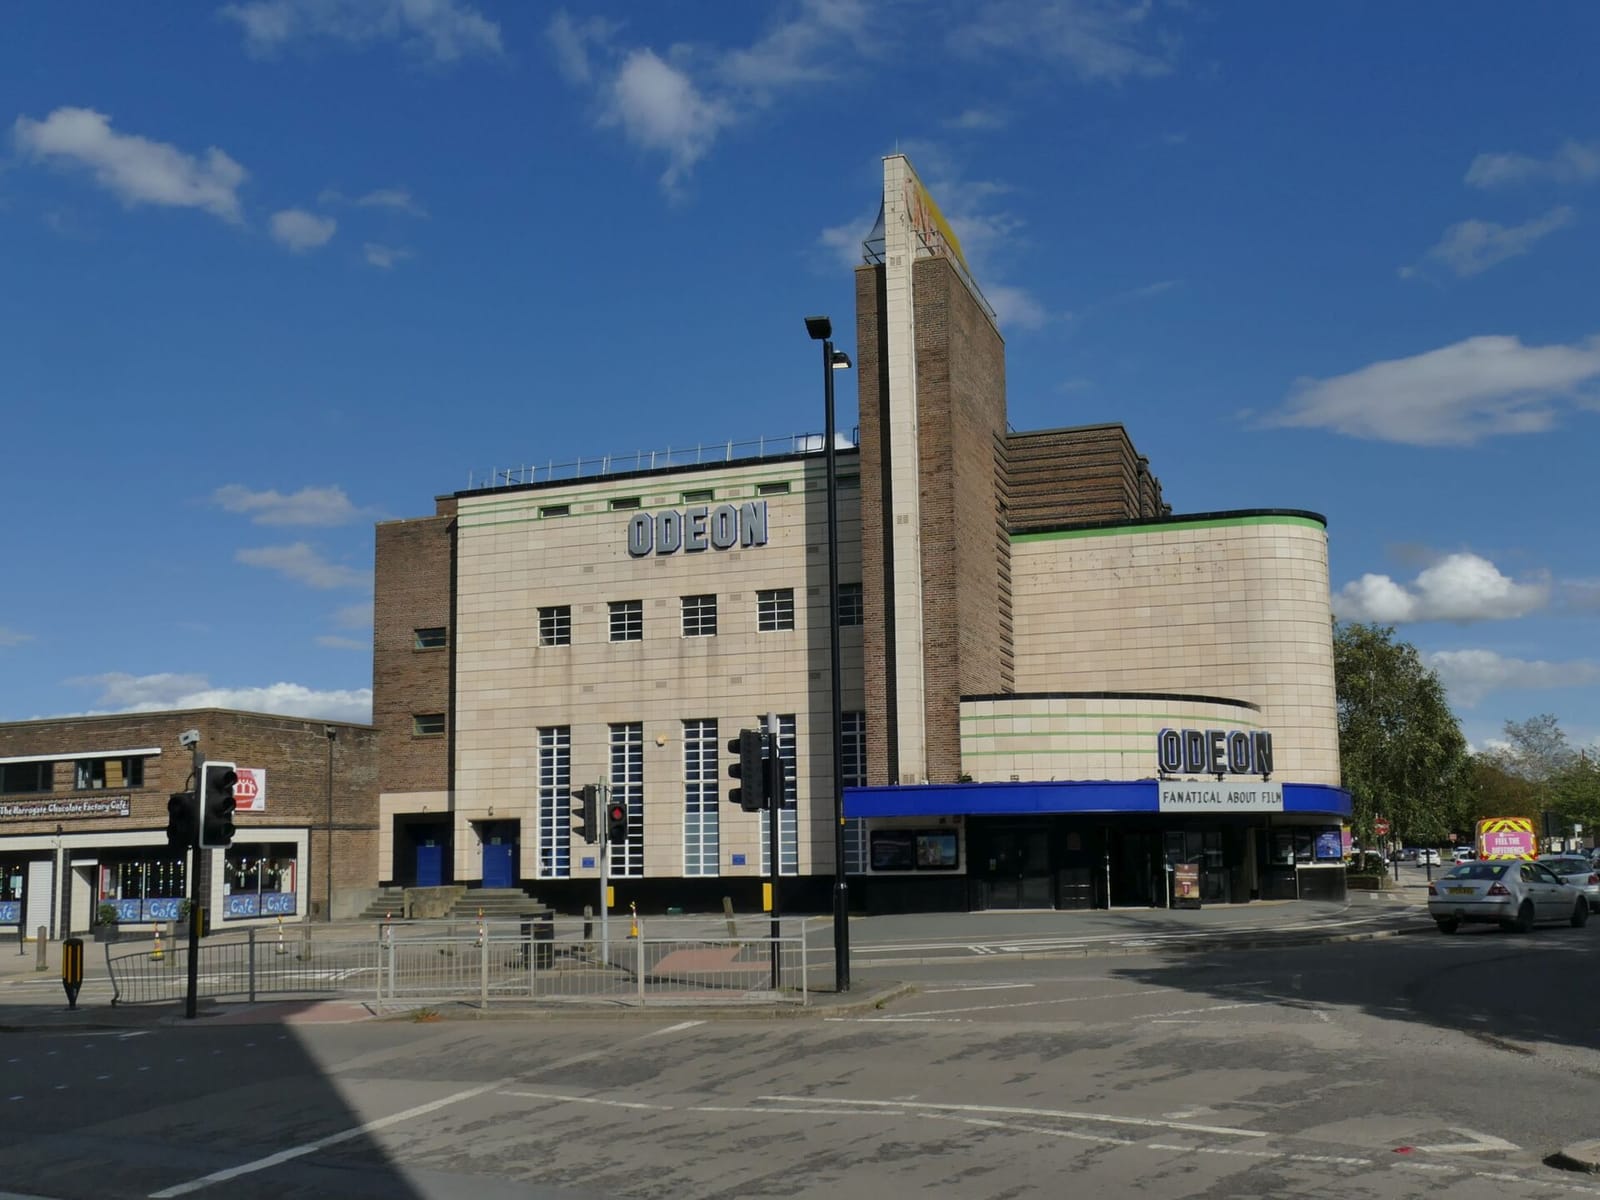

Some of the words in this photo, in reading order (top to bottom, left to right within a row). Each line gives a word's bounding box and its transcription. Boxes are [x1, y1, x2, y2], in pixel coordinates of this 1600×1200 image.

[628, 501, 768, 557] ODEON
[1158, 728, 1274, 774] ODEON
[1163, 791, 1222, 804] FANATICAL
[1227, 791, 1256, 804] ABOUT
[1262, 791, 1282, 804] FILM
[0, 806, 12, 815] The
[13, 805, 46, 816] Harrogate
[48, 803, 82, 813] Chocolate
[83, 801, 110, 812] Factory
[110, 800, 127, 810] Café
[1509, 837, 1520, 846] THE
[116, 903, 133, 919] afé
[150, 902, 177, 918] Café
[231, 899, 253, 914] Café
[267, 897, 289, 911] Café
